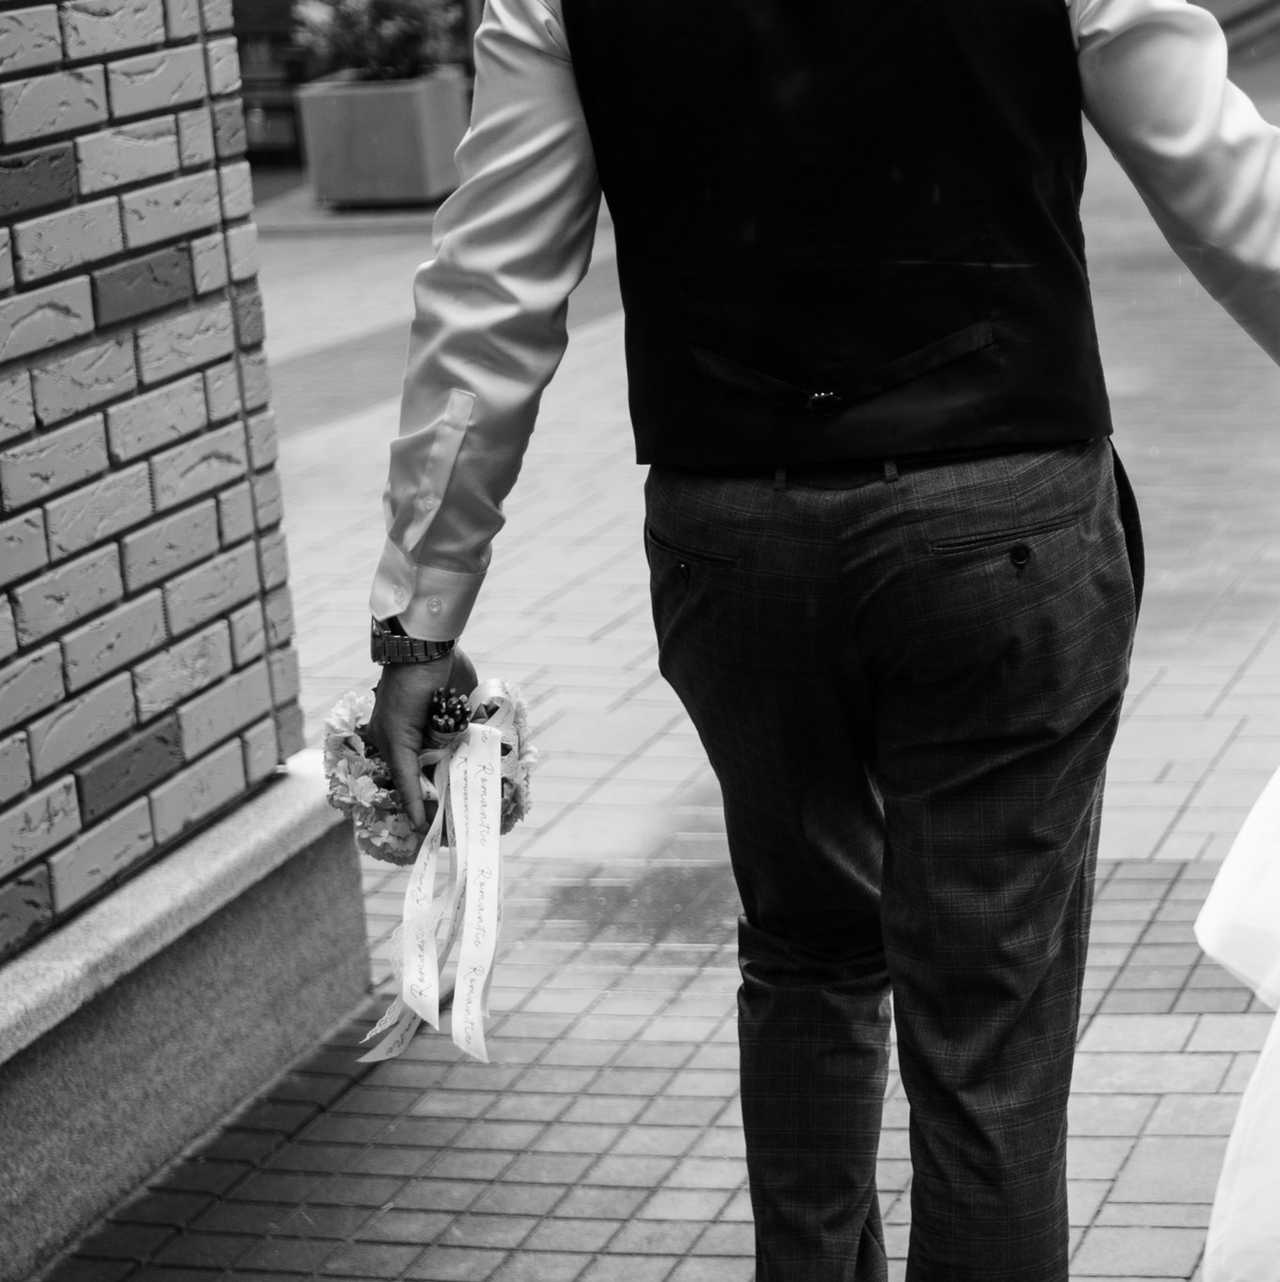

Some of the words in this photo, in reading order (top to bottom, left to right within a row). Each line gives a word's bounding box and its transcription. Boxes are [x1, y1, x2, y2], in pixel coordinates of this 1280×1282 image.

[474, 762, 495, 846] Romantic
[473, 866, 492, 948] Romantic
[463, 964, 485, 1045] Romantic
